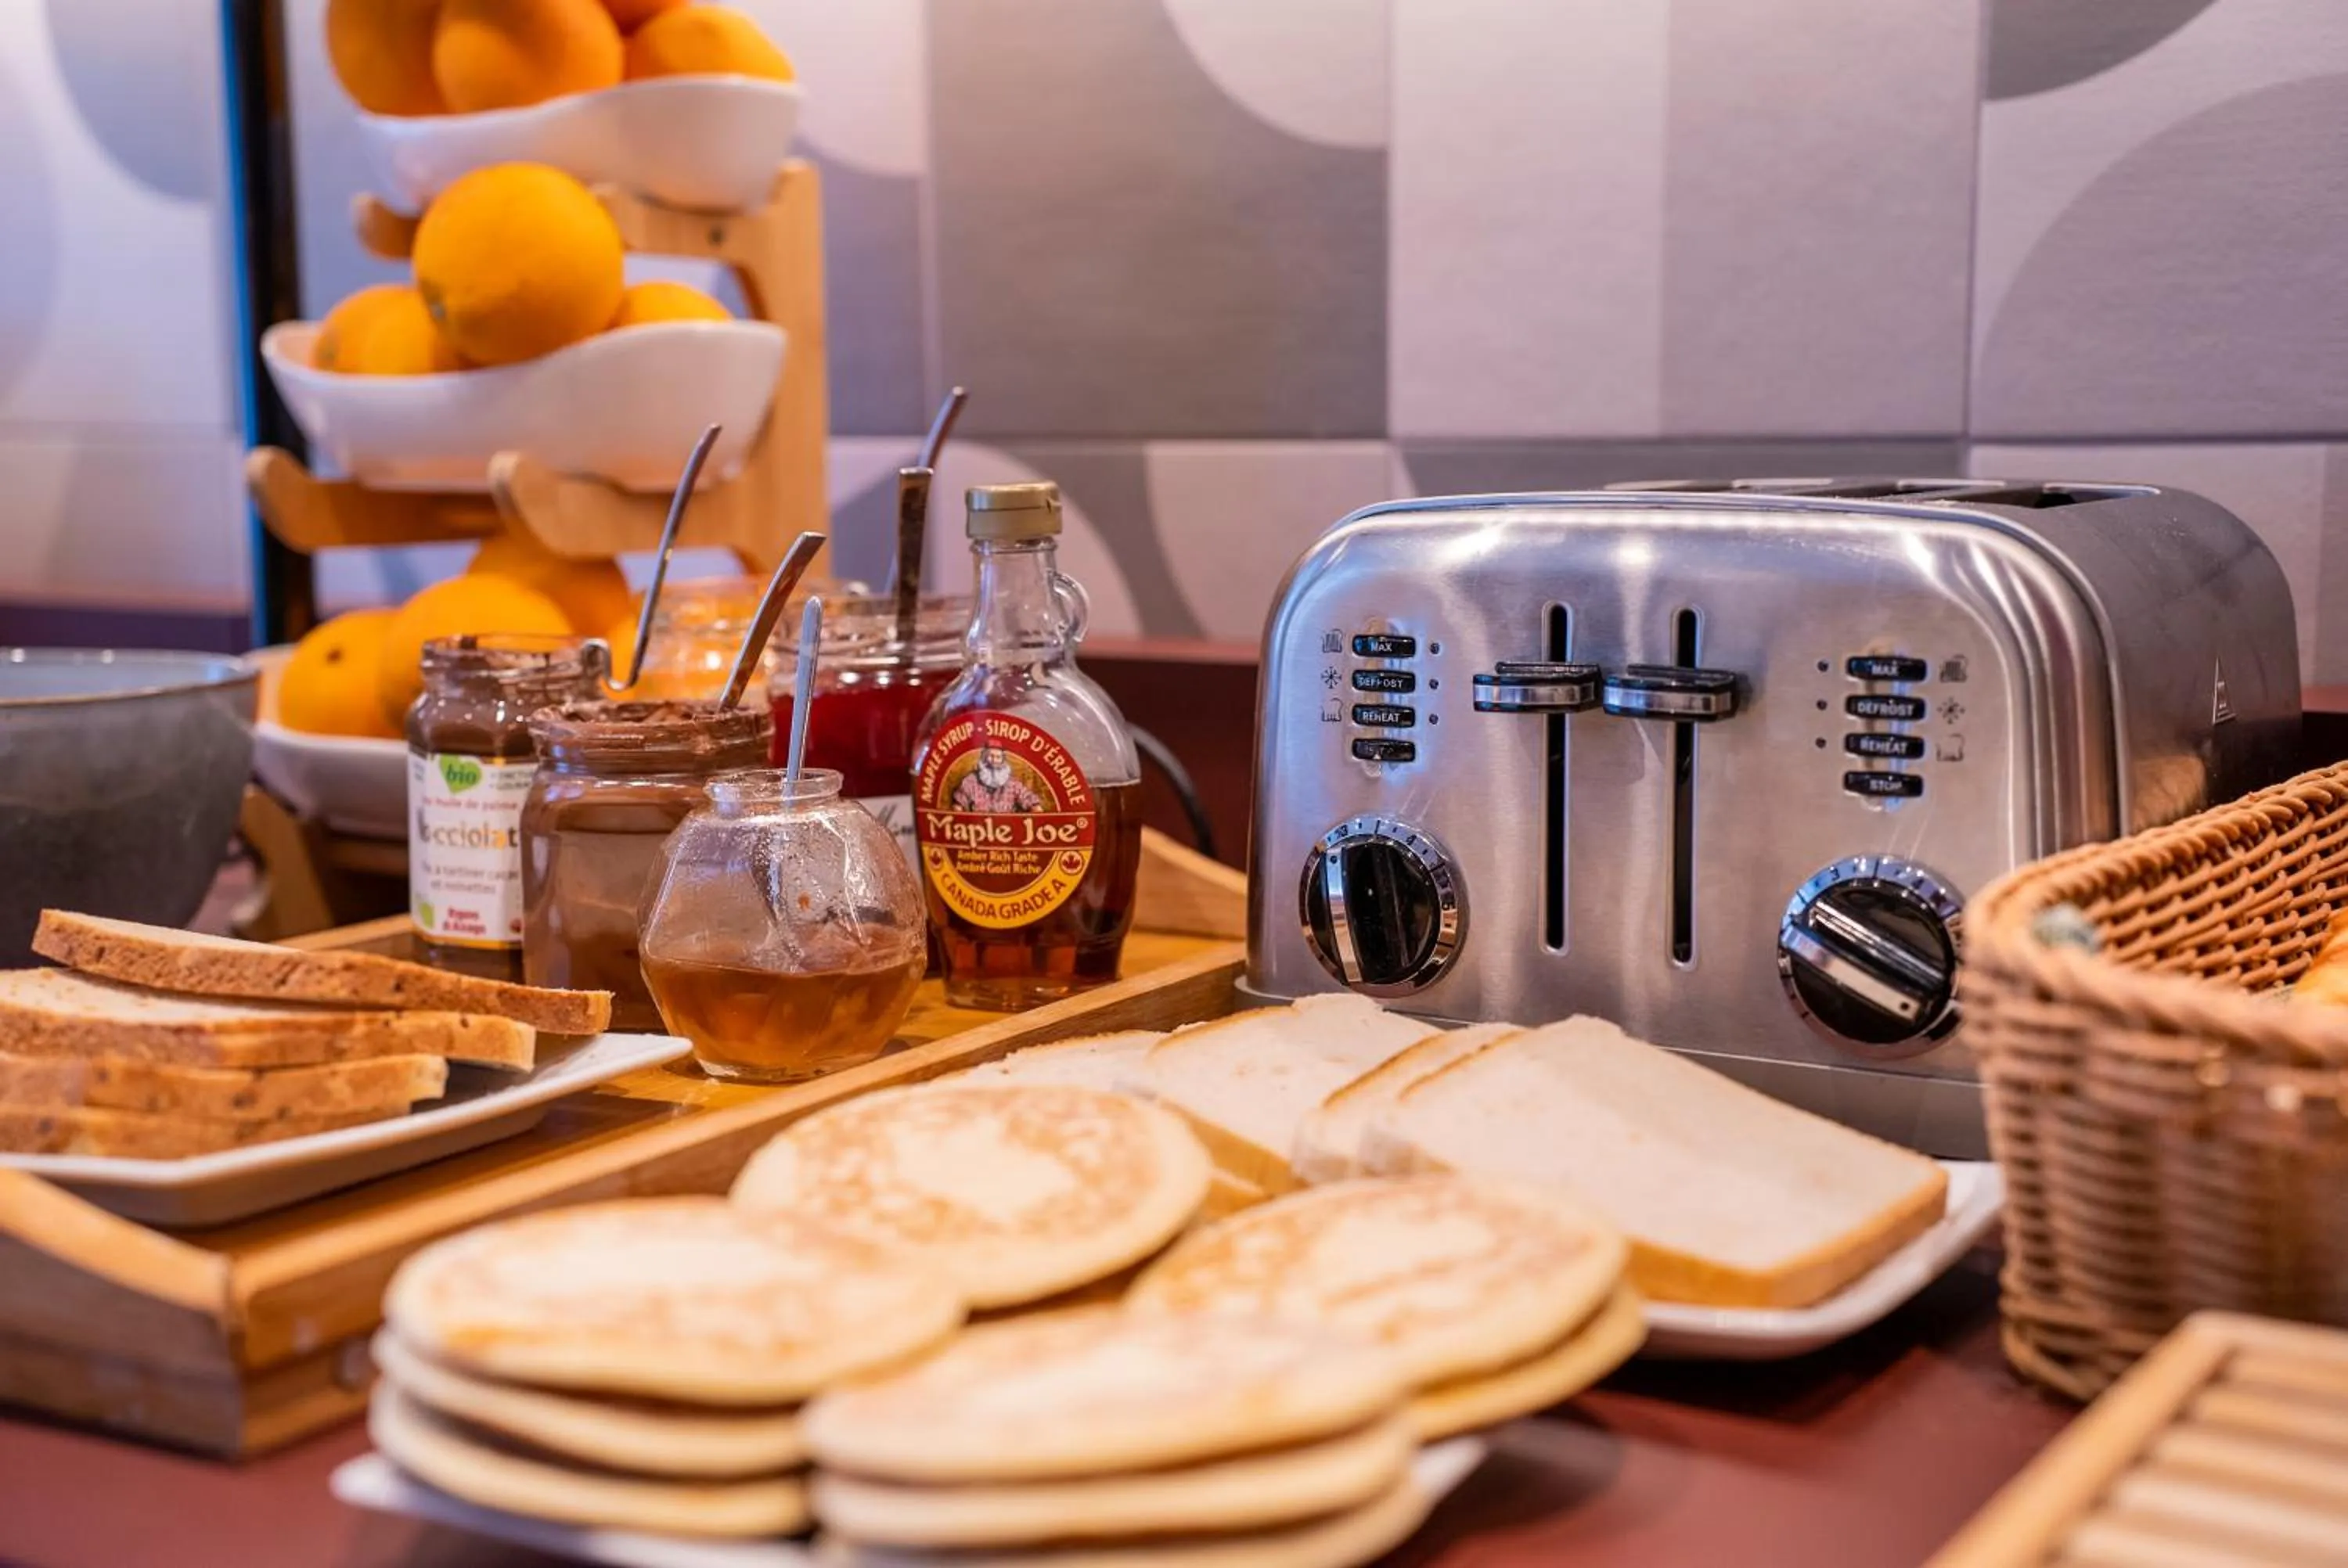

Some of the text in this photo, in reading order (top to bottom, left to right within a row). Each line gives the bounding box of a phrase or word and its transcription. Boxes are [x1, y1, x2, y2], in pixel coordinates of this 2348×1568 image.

[1871, 664, 1898, 675] MAX
[1857, 701, 1914, 715] DEFROST
[1363, 711, 1400, 722] REHEAT
[1860, 739, 1907, 753] REHEAT
[921, 750, 942, 803] MAPLE
[938, 722, 974, 756] SYRUP
[985, 719, 1031, 743] SIROP
[1031, 735, 1086, 806] D'ÉRABLE
[446, 764, 477, 784] bio
[927, 814, 1013, 848] Maple
[990, 851, 1011, 861] Rich
[941, 873, 1067, 920] CANADA GRADE A
